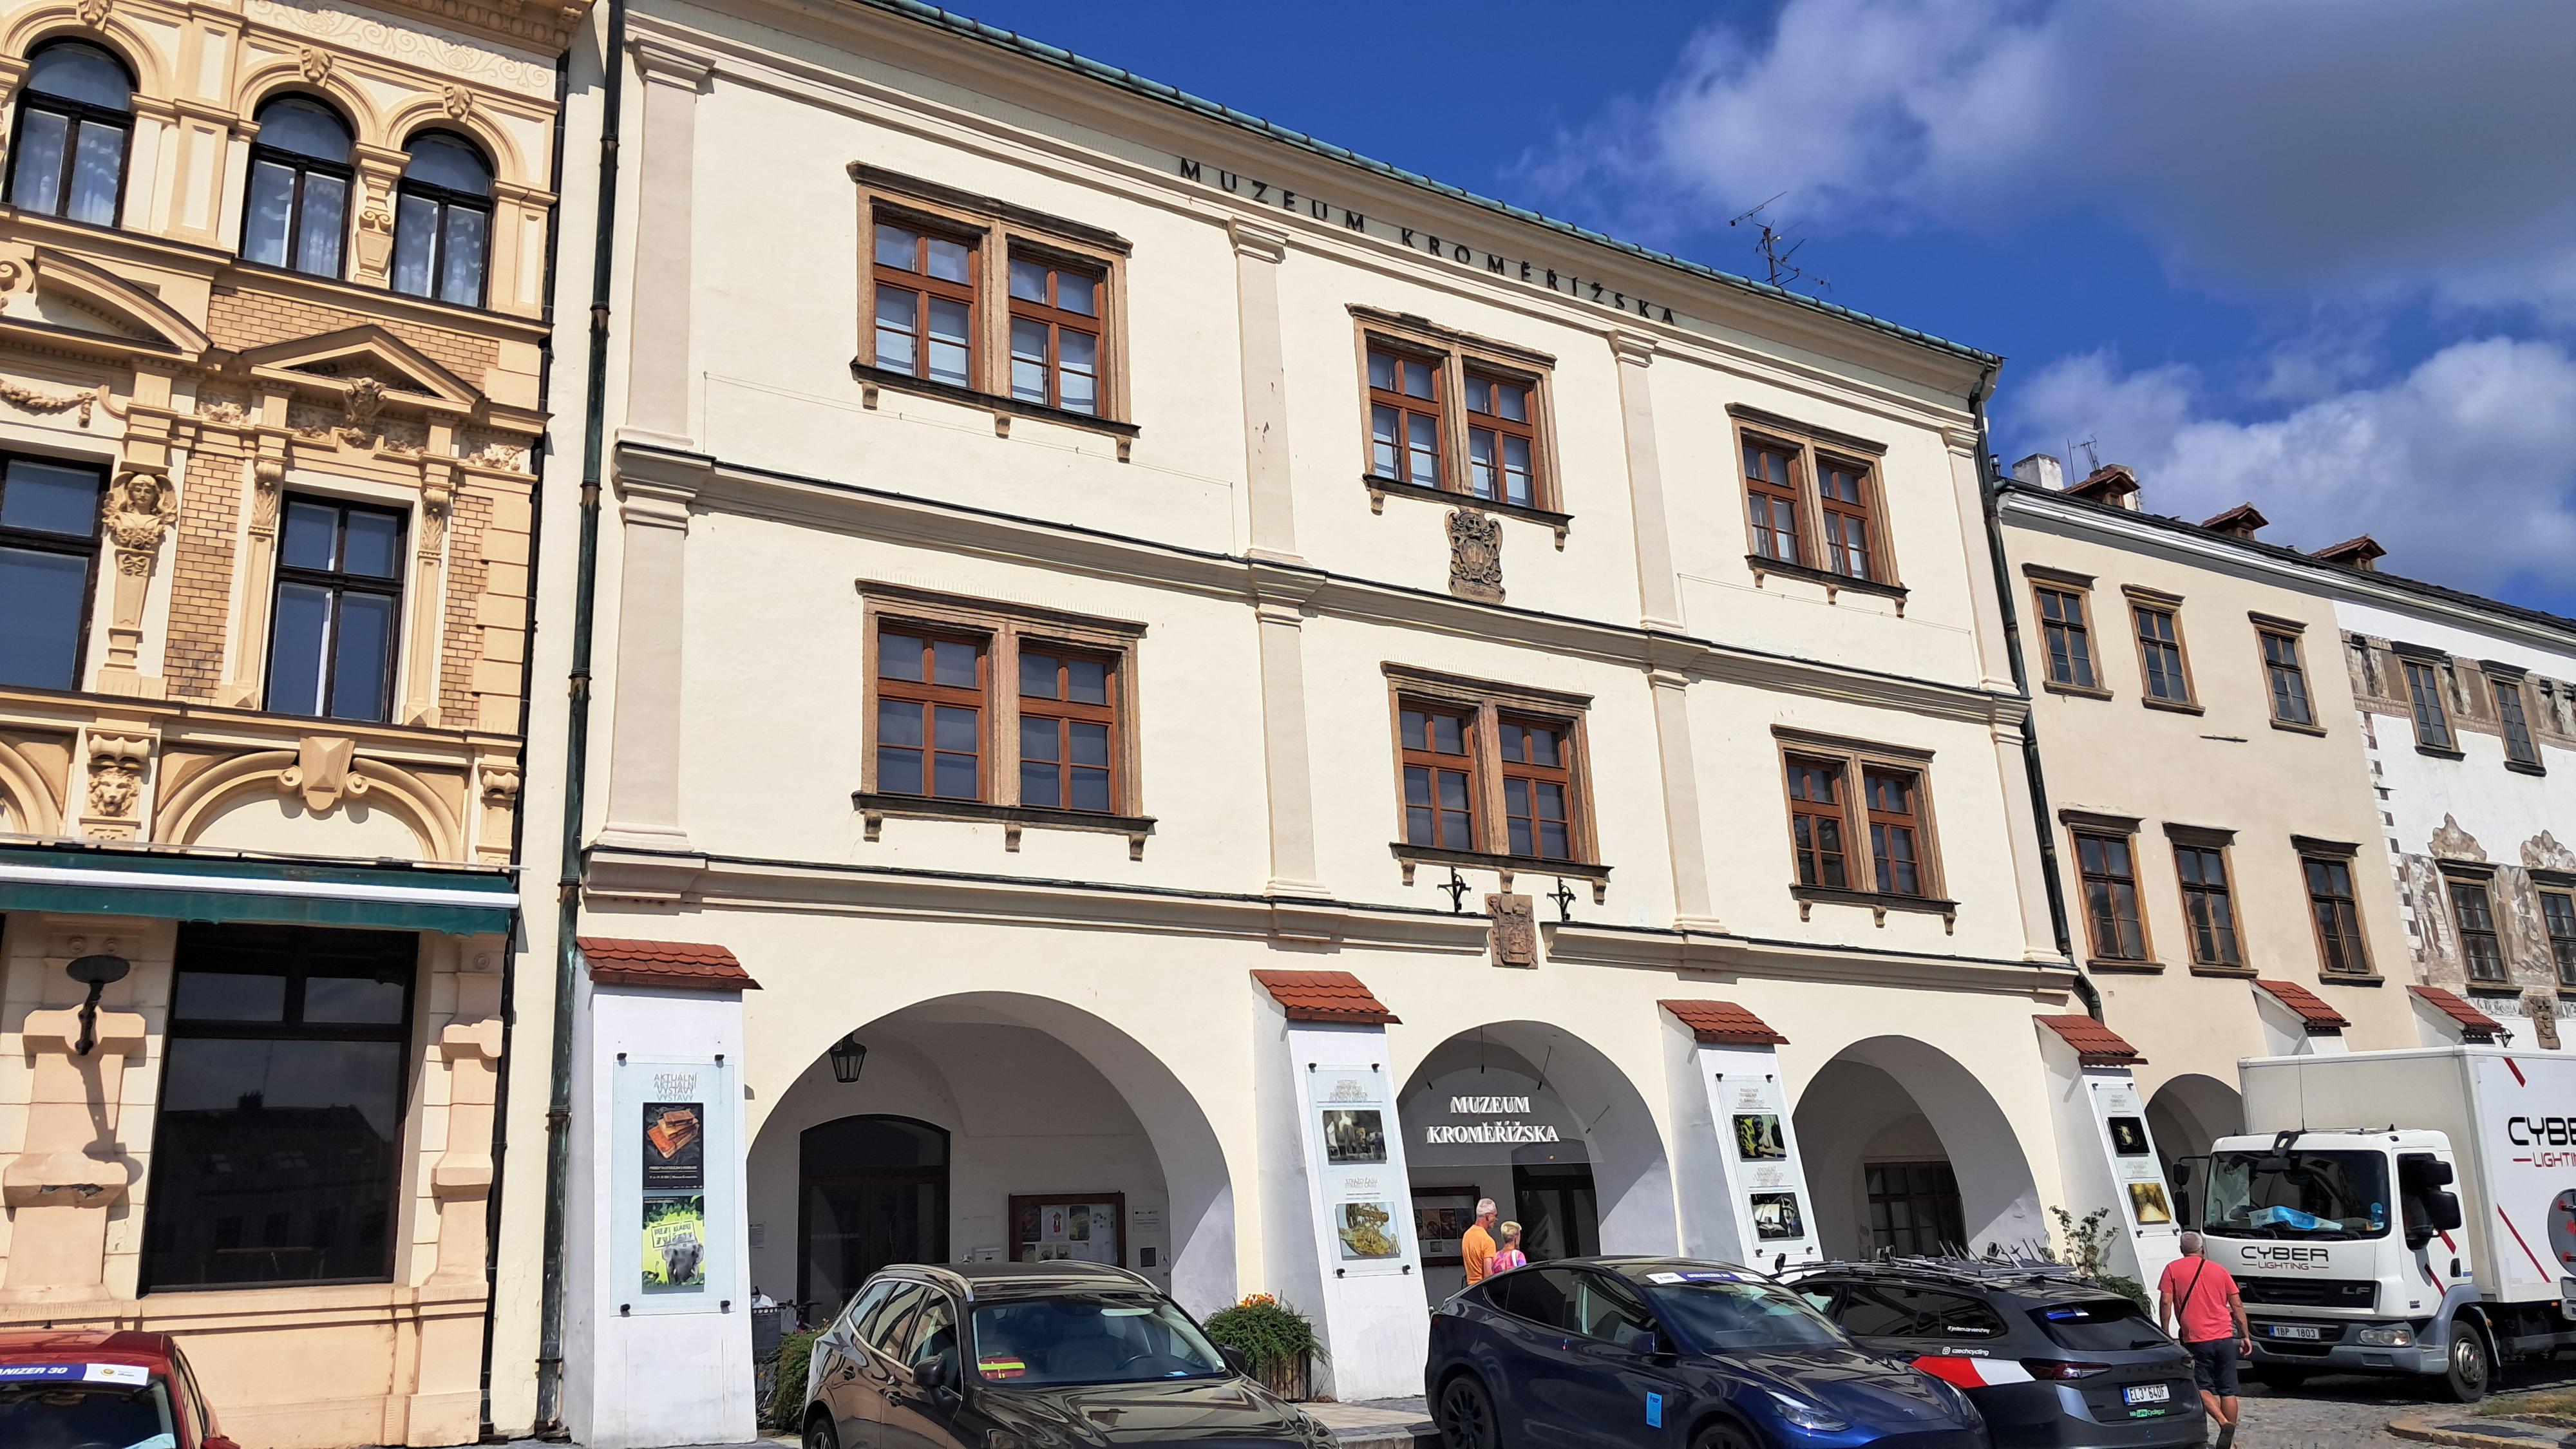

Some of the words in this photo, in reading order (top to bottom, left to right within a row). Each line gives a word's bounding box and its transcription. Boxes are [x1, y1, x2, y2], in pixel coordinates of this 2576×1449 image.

[1180, 158, 1365, 233] MUZEUM
[654, 1072, 697, 1083] AKTUÁLNÍ
[1450, 1096, 1531, 1113] MUZEUM
[1426, 1121, 1560, 1143] KROMĚŘÍŽSKA
[2532, 1151, 2576, 1167] LIGHTI
[2240, 1246, 2329, 1262] CYBER
[2258, 1262, 2309, 1270] LIGHTING
[2342, 1286, 2371, 1294] LF
[2277, 1327, 2289, 1336] 1BP
[2297, 1329, 2315, 1338] 1803
